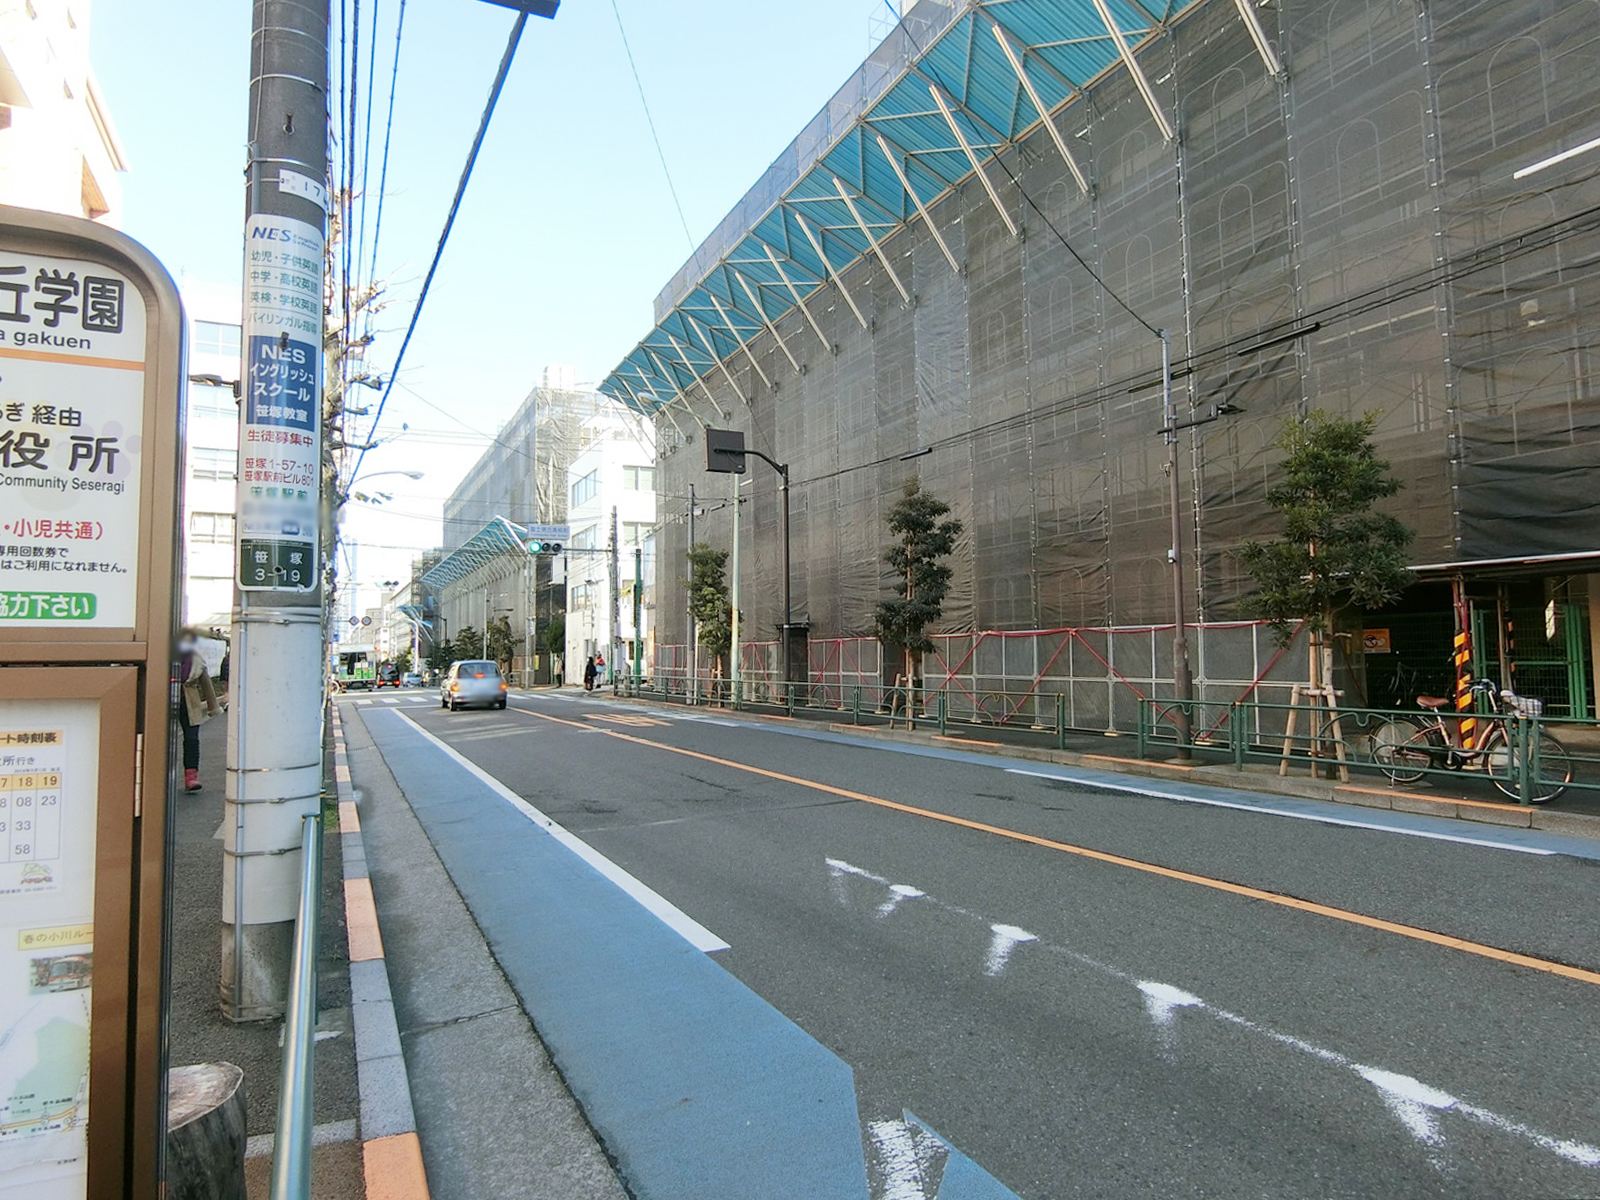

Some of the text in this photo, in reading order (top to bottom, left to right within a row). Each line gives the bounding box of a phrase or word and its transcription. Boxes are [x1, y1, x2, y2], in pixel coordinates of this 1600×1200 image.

[252, 226, 292, 242] NES
[251, 250, 319, 275] 幼児・子供英語
[250, 270, 318, 295] 中学・高校英語
[0, 266, 125, 334] 丘学園
[250, 291, 317, 315] 英検・学校英語
[248, 312, 317, 334] バイリンガル指導
[13, 331, 91, 349] gakuen
[261, 344, 306, 364] NES
[250, 363, 314, 385] イングリッシュ
[254, 382, 311, 402] スクール
[0, 402, 82, 427] ぎ 経由
[256, 404, 308, 423] 笹塚教室
[247, 429, 314, 448] 生徒募集中
[71, 477, 125, 495] Seseragi
[1, 560, 128, 573] はご利用になれません。
[255, 567, 301, 582] 3-19
[18, 776, 33, 788] 18
[43, 775, 58, 786] 19
[16, 796, 32, 807] 08
[41, 795, 57, 806] 23
[15, 820, 31, 831] 33
[15, 844, 31, 855] 58
